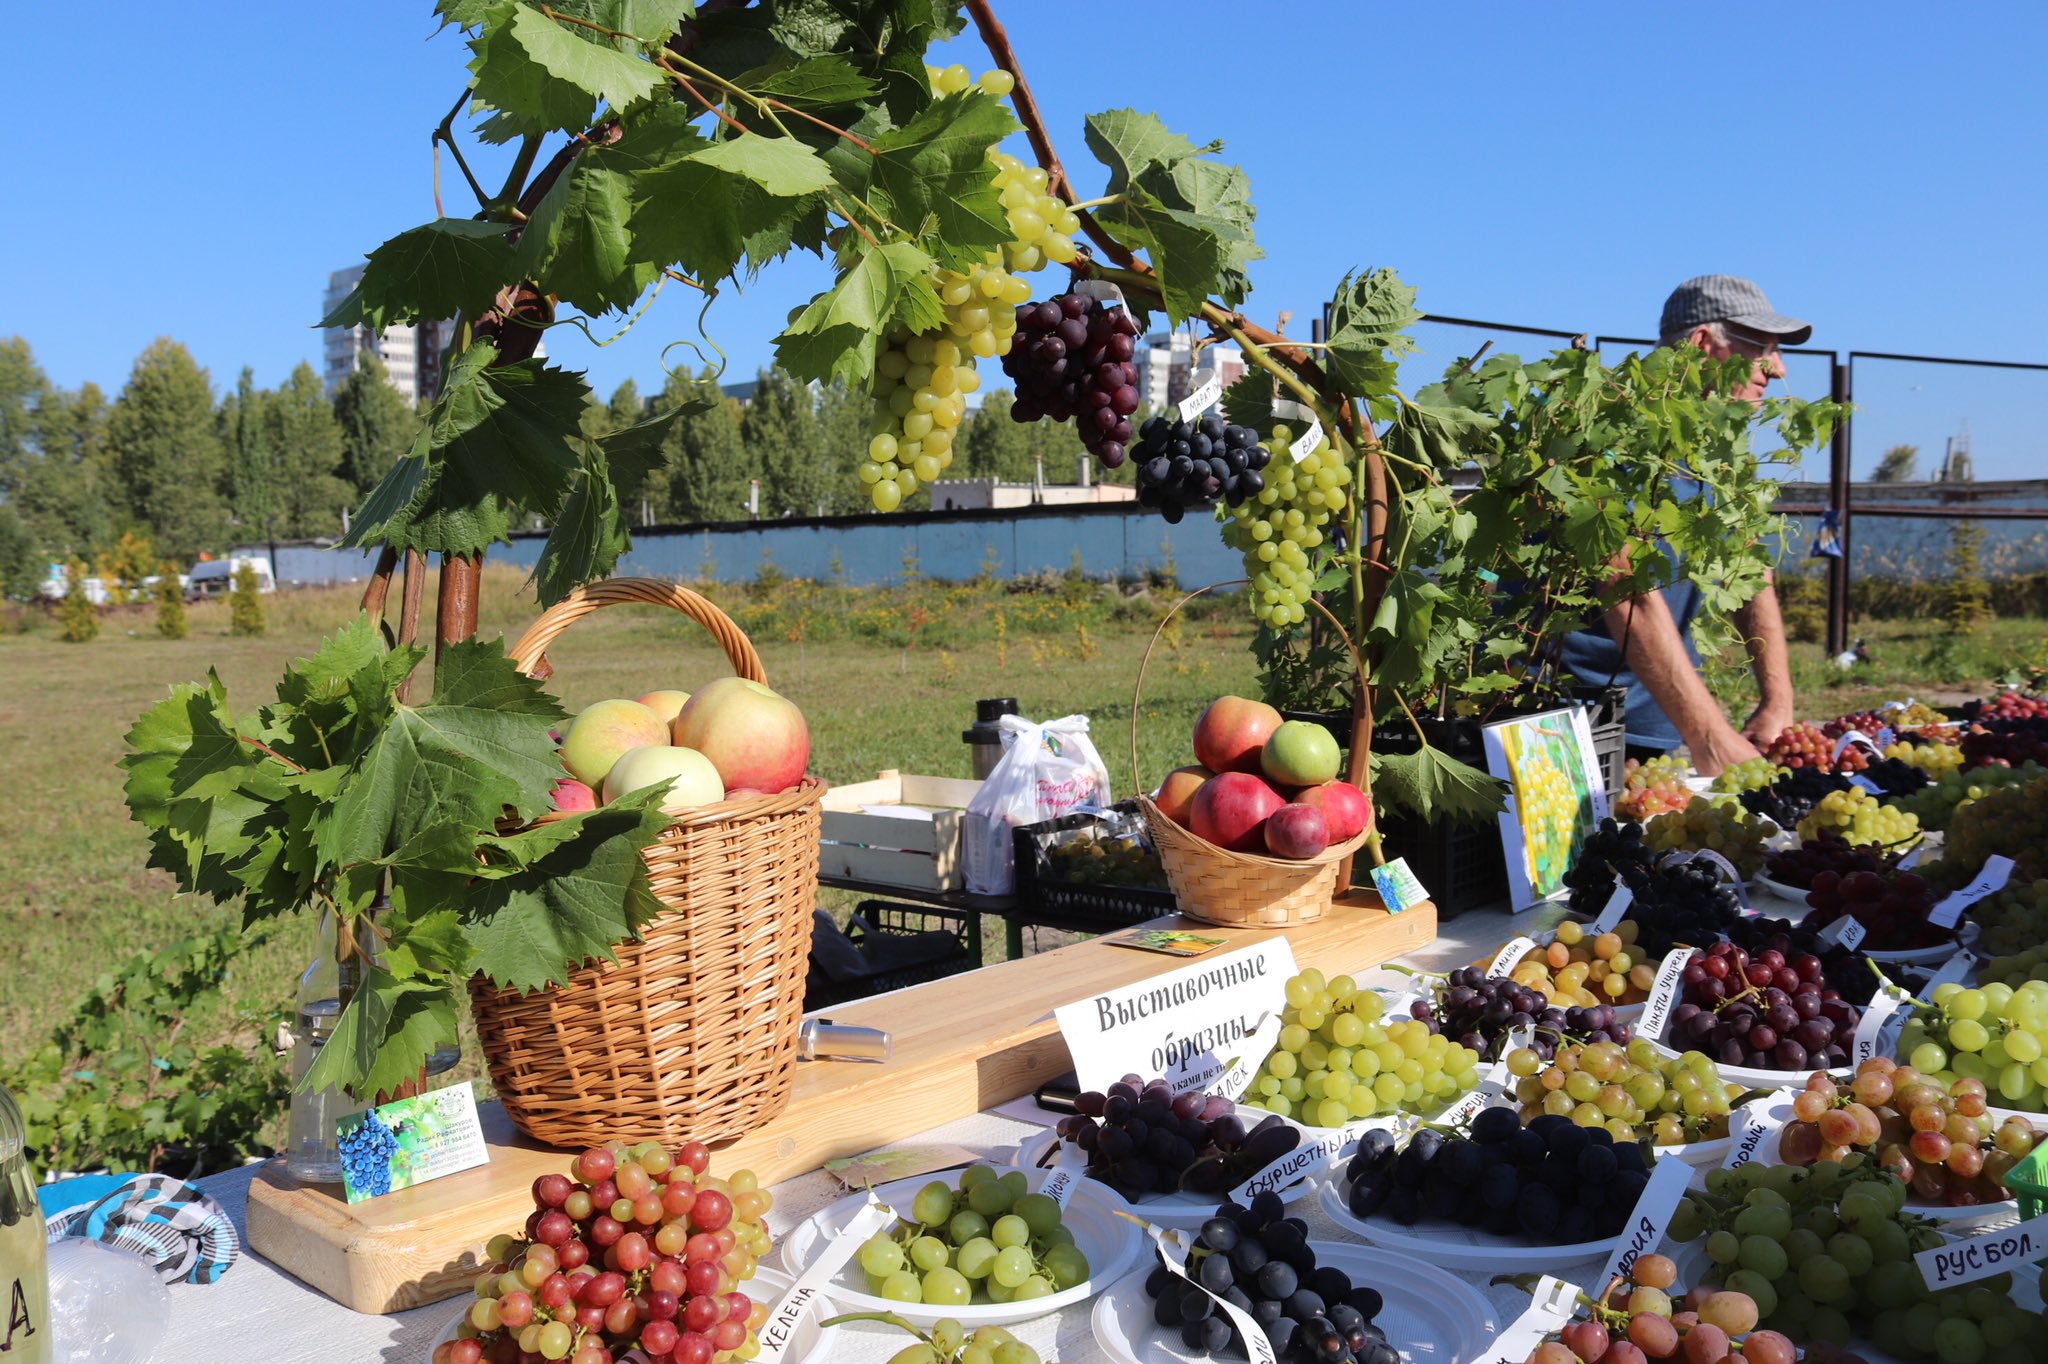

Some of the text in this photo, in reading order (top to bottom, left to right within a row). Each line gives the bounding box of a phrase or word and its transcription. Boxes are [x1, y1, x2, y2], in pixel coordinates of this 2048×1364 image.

[1095, 954, 1268, 1032] Выставочные
[1151, 1015, 1248, 1072] образцы
[1171, 1073, 1201, 1096] уками
[1202, 1069, 1213, 1080] не
[762, 1288, 816, 1352] ХЕЛЕНА
